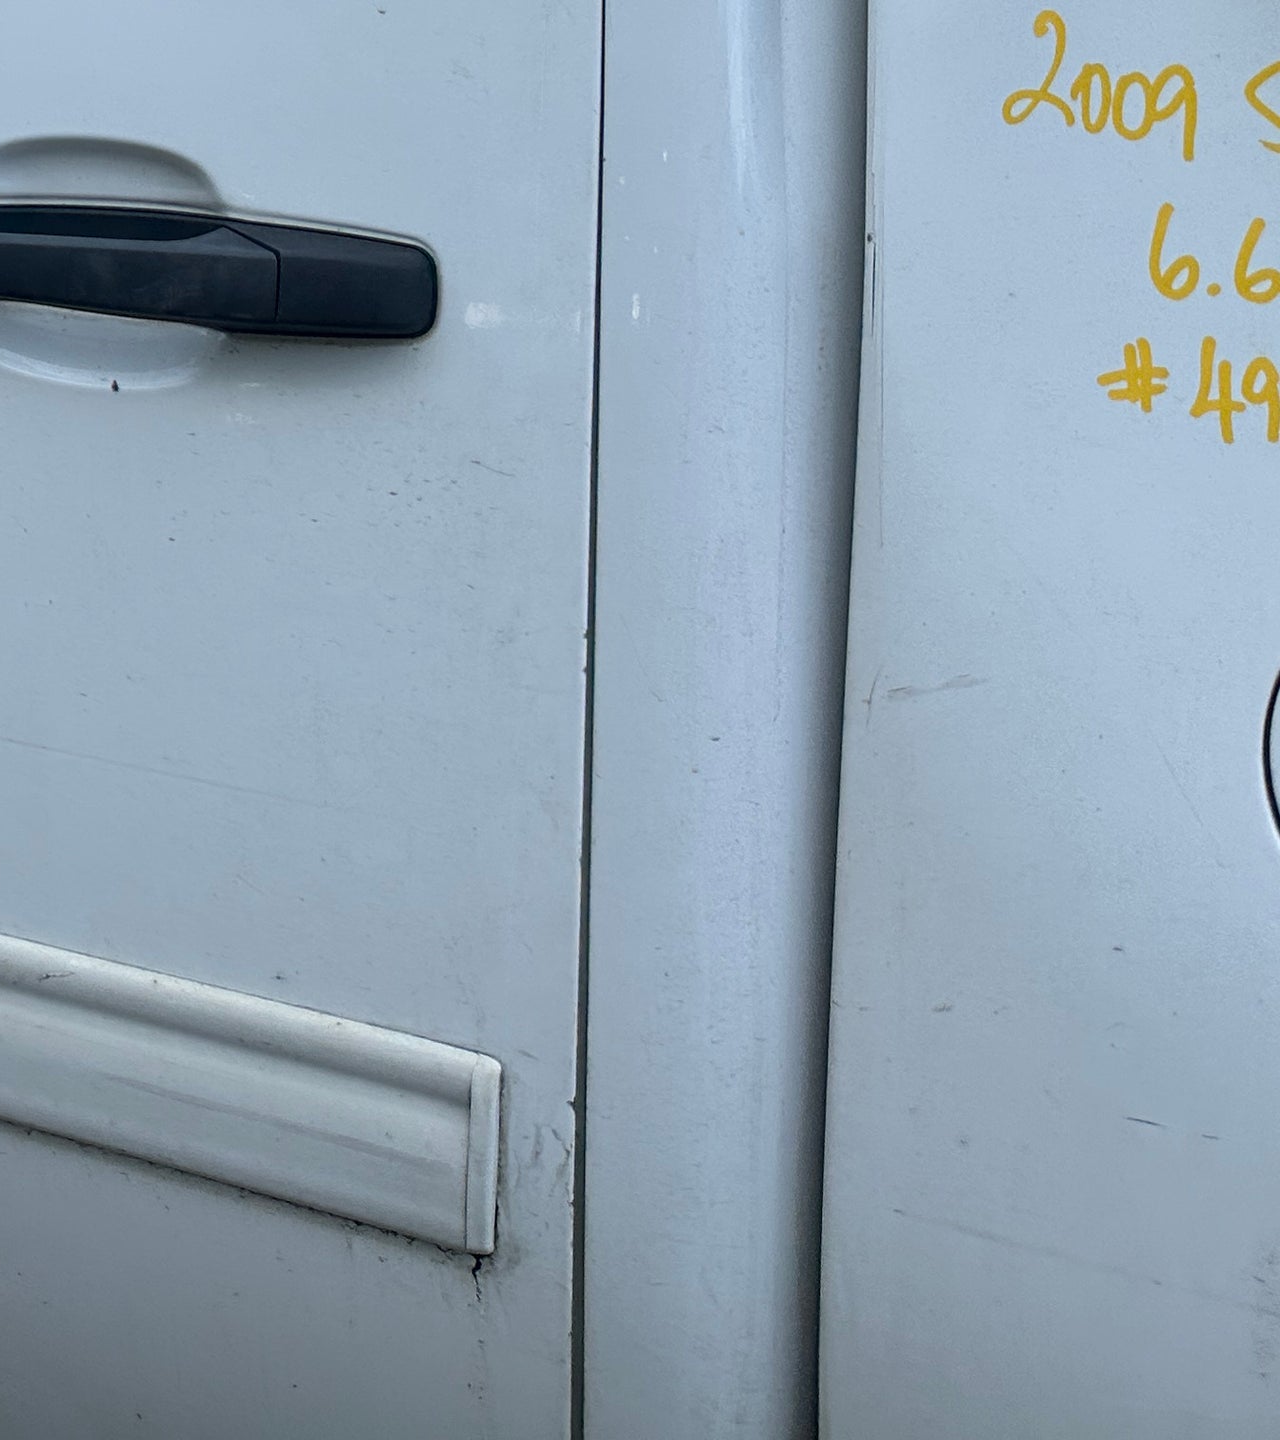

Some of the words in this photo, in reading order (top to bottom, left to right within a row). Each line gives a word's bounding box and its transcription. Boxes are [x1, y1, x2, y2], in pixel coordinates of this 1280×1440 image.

[1002, 10, 1198, 162] 2009
[1149, 202, 1280, 305] 6.6
[1096, 336, 1280, 445] #49
